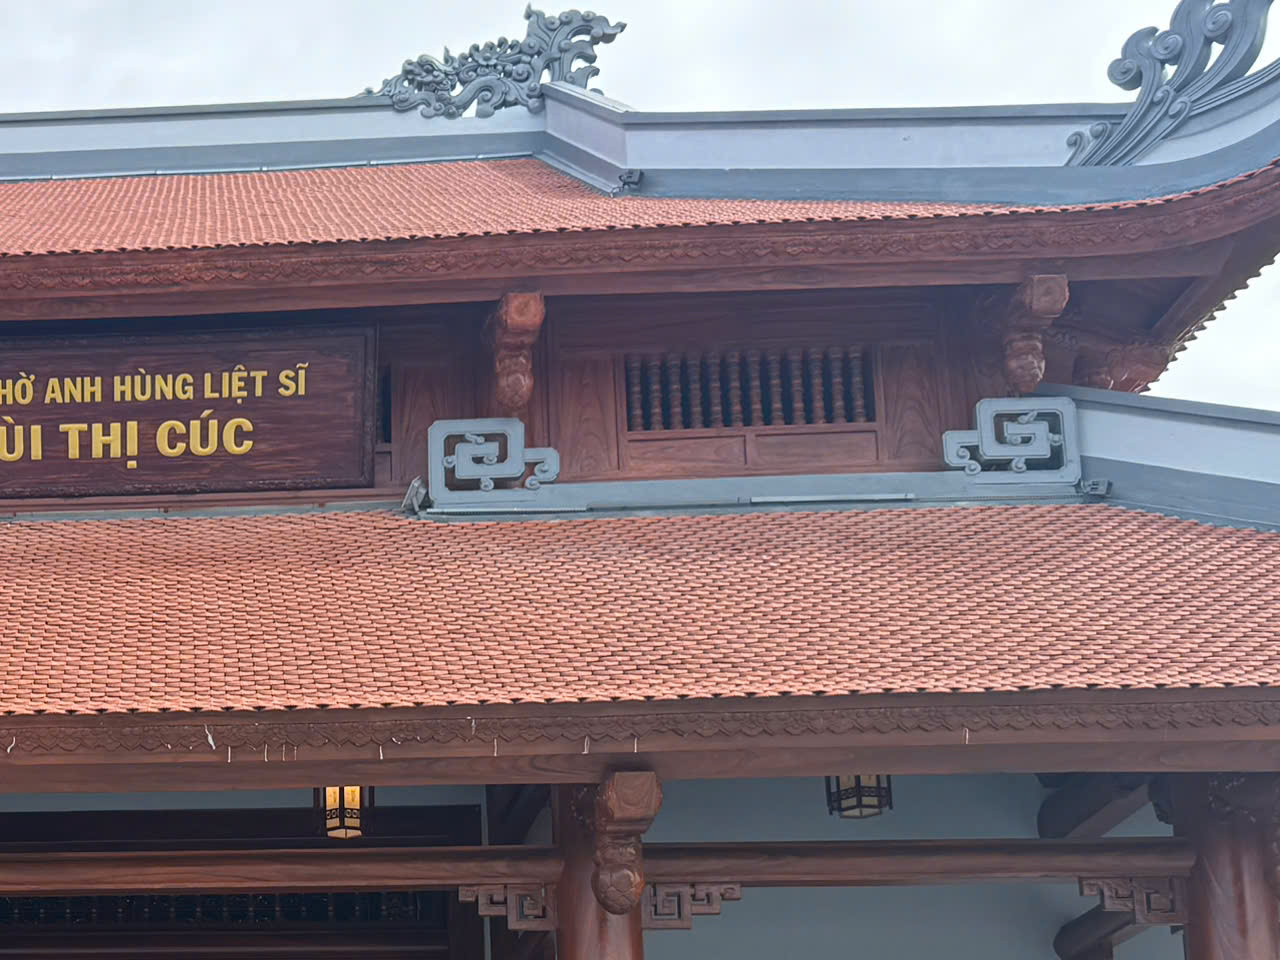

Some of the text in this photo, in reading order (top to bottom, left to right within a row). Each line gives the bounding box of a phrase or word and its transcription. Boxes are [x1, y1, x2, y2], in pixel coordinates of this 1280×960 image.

[45, 376, 102, 404] ANH
[113, 368, 194, 402] HÙNG
[203, 364, 269, 405] LIỆT
[278, 362, 309, 397] SĨ
[59, 420, 138, 470] THỊ
[155, 409, 255, 457] CÚC
